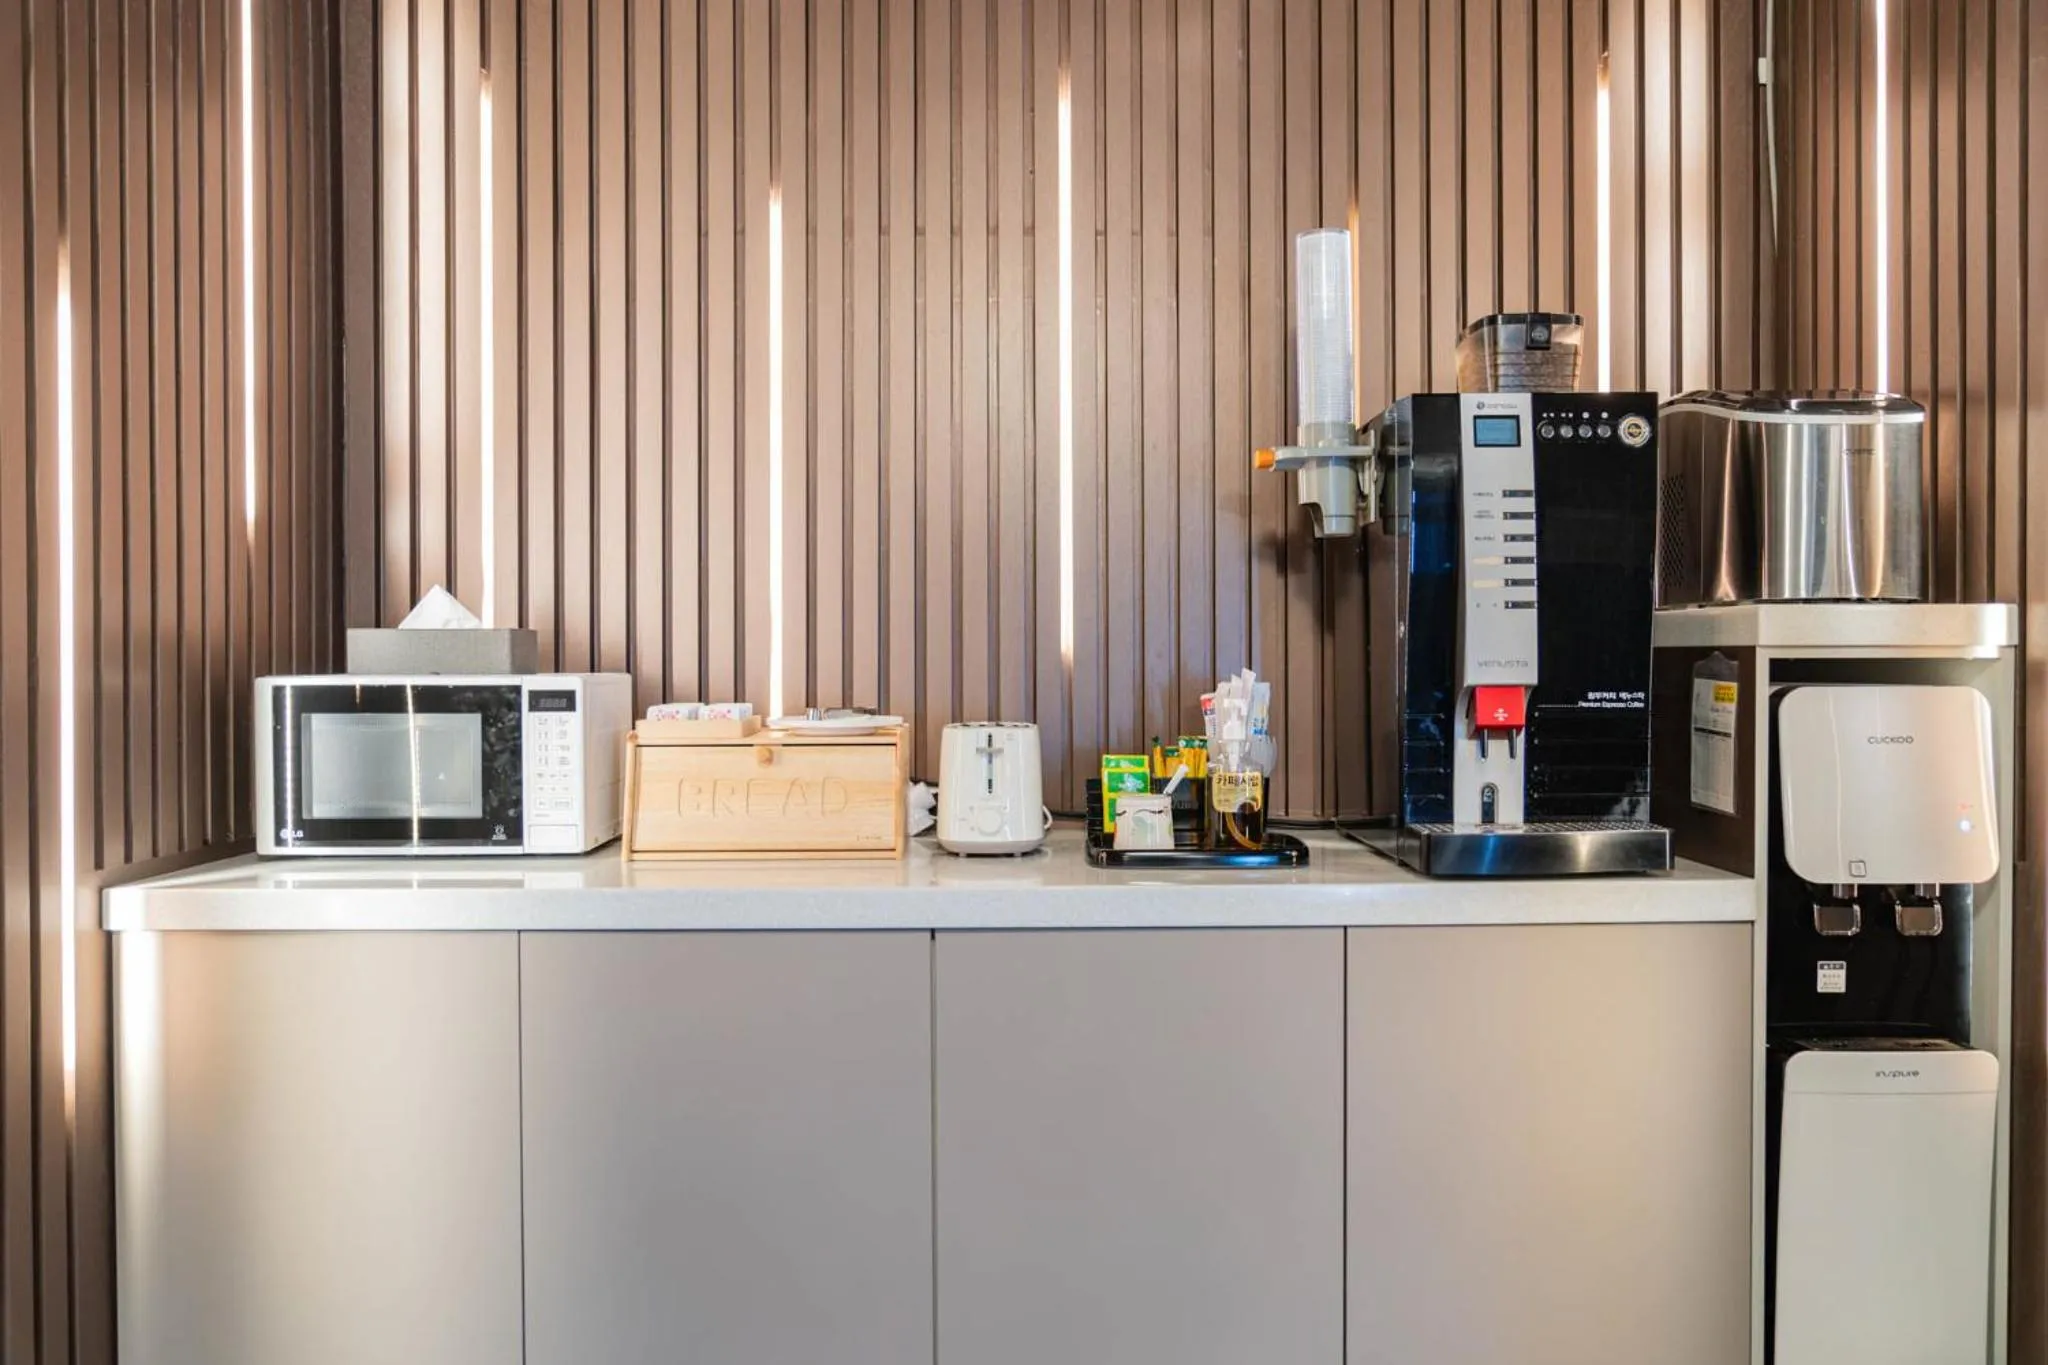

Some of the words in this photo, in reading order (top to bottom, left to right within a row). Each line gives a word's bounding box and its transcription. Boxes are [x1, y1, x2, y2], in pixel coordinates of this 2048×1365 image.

[1627, 700, 1645, 708] Coffee
[1867, 735, 1914, 745] CUCKOO
[678, 776, 849, 817] BREAD
